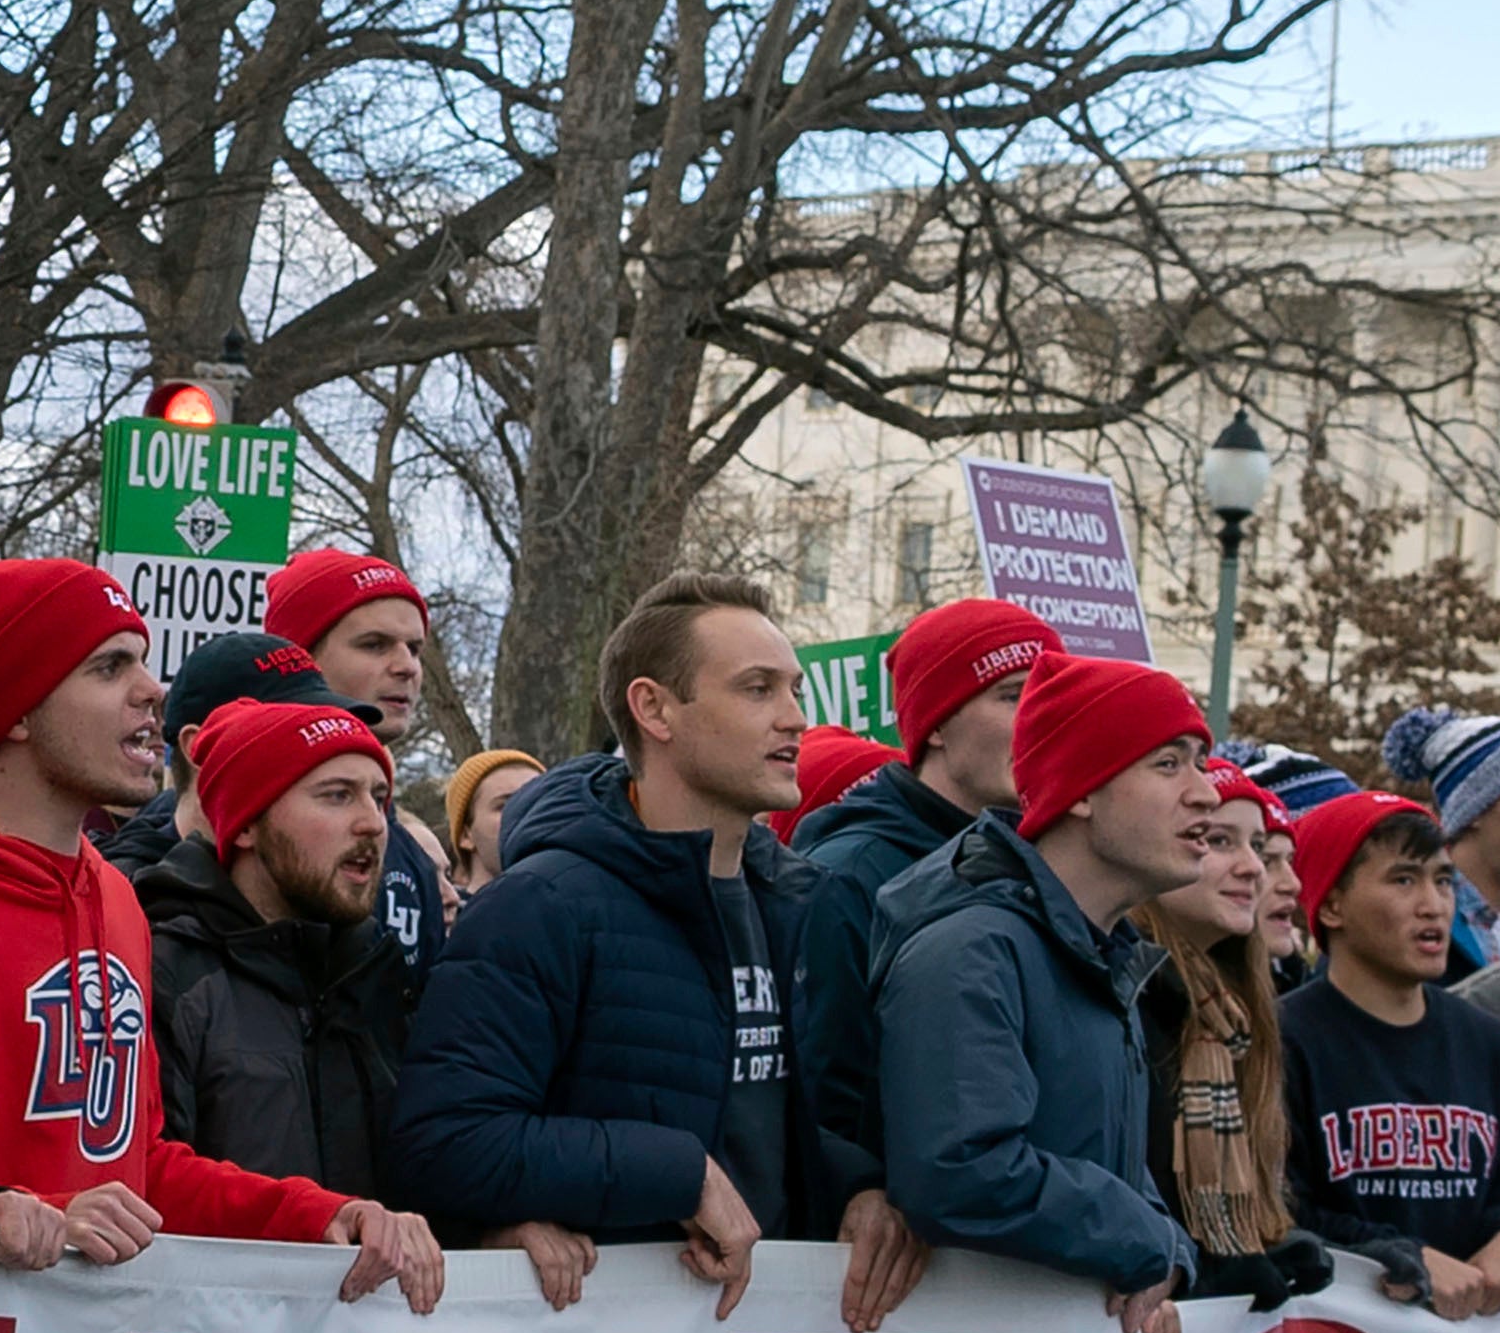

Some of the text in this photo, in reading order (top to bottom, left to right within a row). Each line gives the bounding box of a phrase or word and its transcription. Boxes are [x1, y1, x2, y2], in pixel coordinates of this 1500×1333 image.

[128, 429, 289, 497] LOVE LIFE
[993, 500, 1109, 545] I DEMAND
[987, 542, 1135, 593] PROTECTION
[131, 561, 267, 627] CHOOSE
[1030, 595, 1141, 632] CONCEPTION
[972, 640, 1045, 677] LIBERTY
[385, 889, 421, 946] LU
[732, 965, 781, 1015] ER
[1320, 1102, 1499, 1183] LIBERTY
[1356, 1177, 1478, 1199] UNIVERSITY
